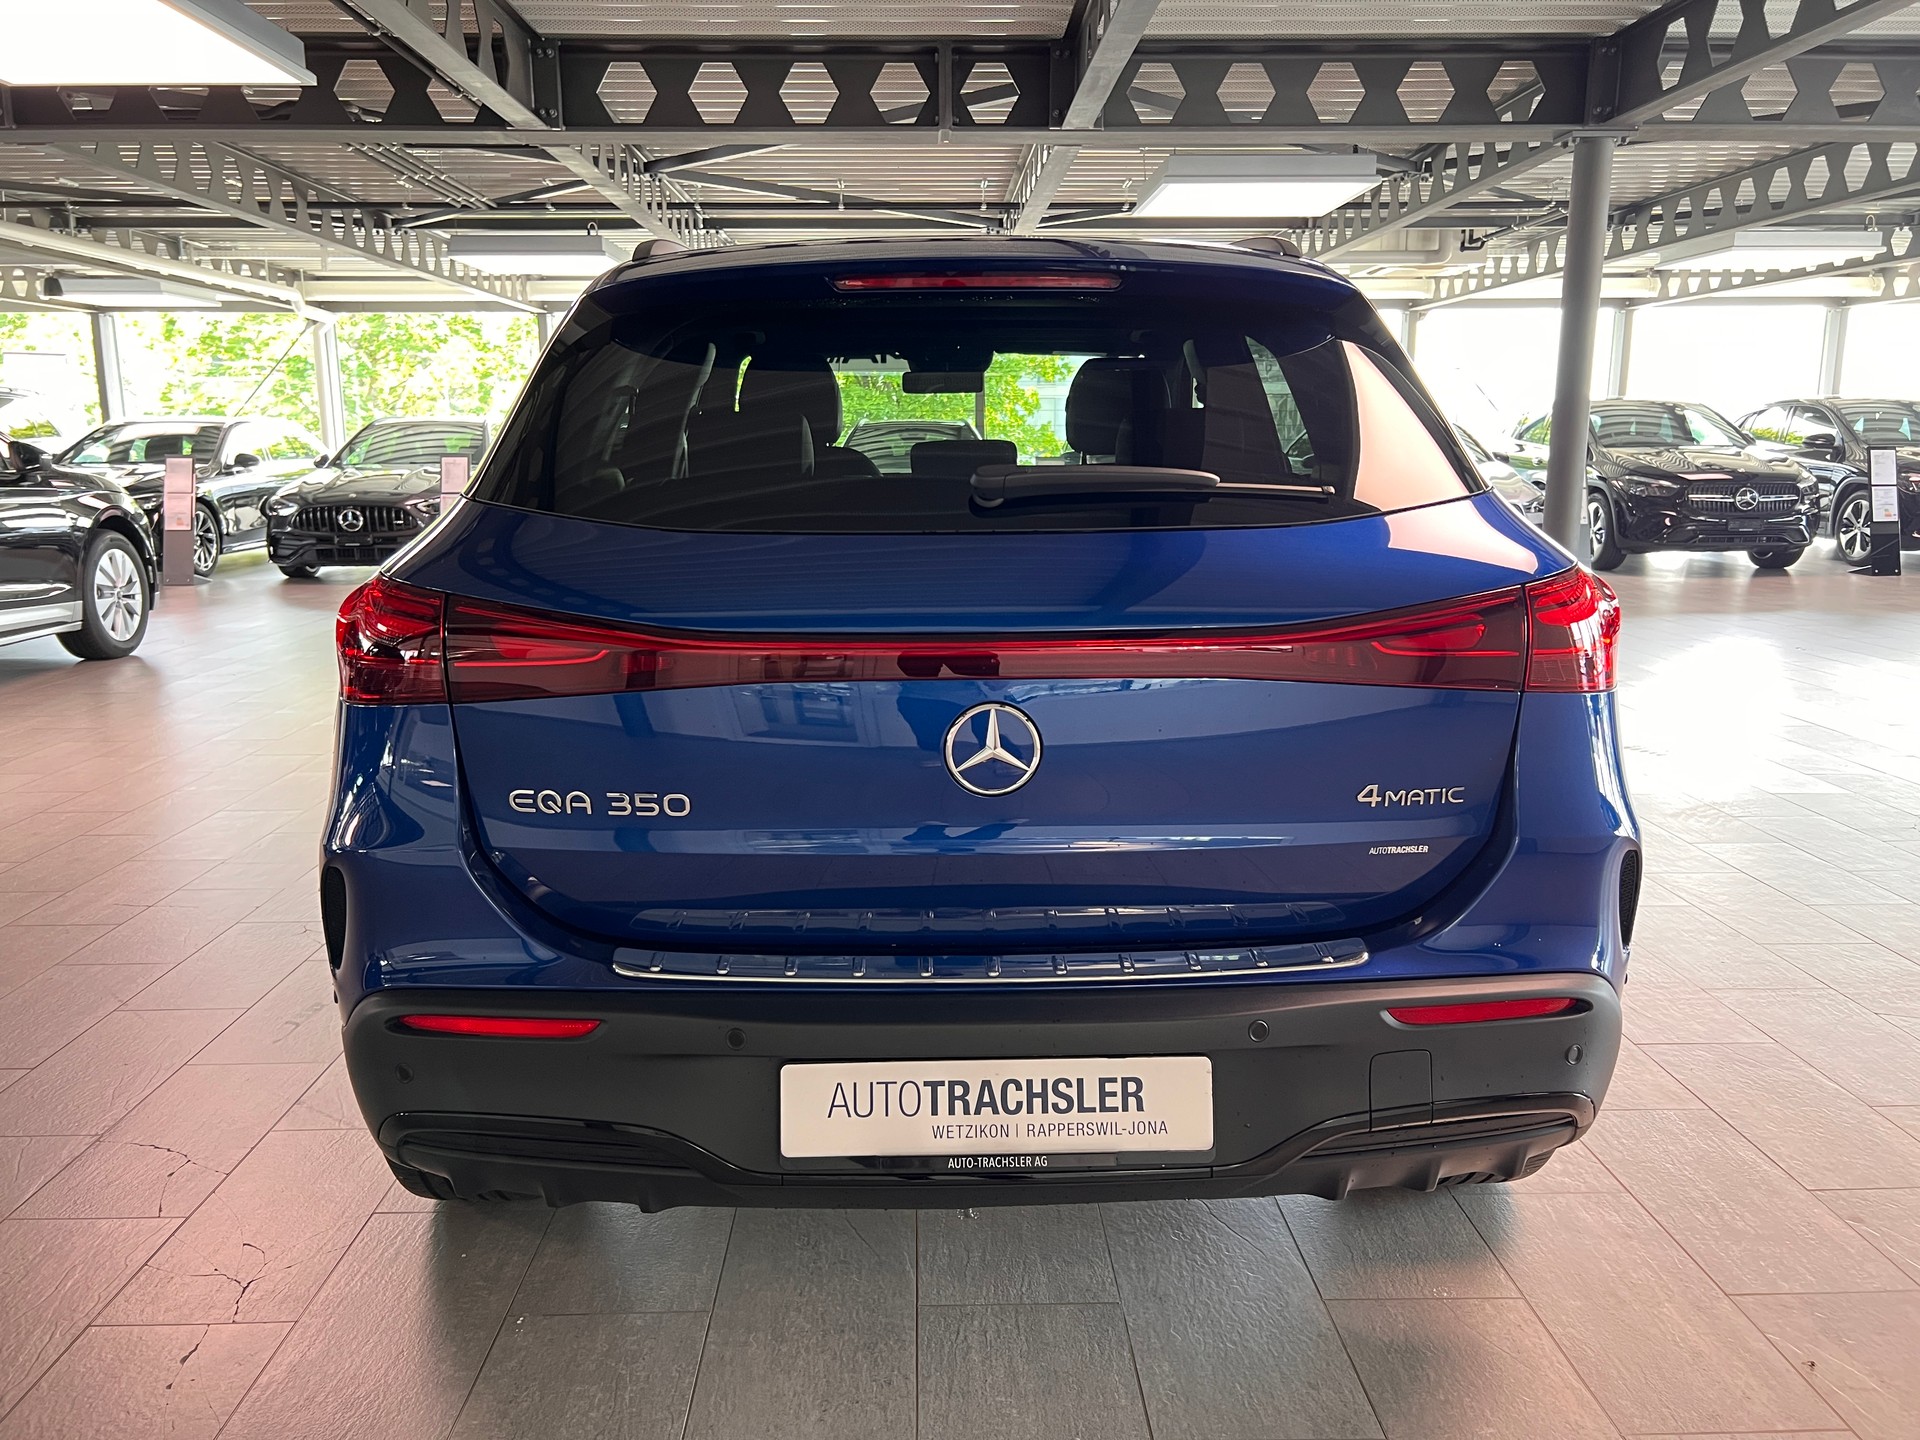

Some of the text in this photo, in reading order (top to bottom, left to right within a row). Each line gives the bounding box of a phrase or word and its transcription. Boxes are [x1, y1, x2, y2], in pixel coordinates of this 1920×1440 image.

[508, 789, 692, 817] EQA 350
[1357, 784, 1465, 808] 4MATIC
[1368, 845, 1429, 855] AUTOTRACHSLER
[827, 1076, 1145, 1119] AUTOTRACHSLER
[931, 1124, 1010, 1139] WETZIKON
[1026, 1121, 1169, 1138] RAPPERSWIL-JONA
[947, 1156, 1048, 1169] AUTO-TRACHSLER AG
